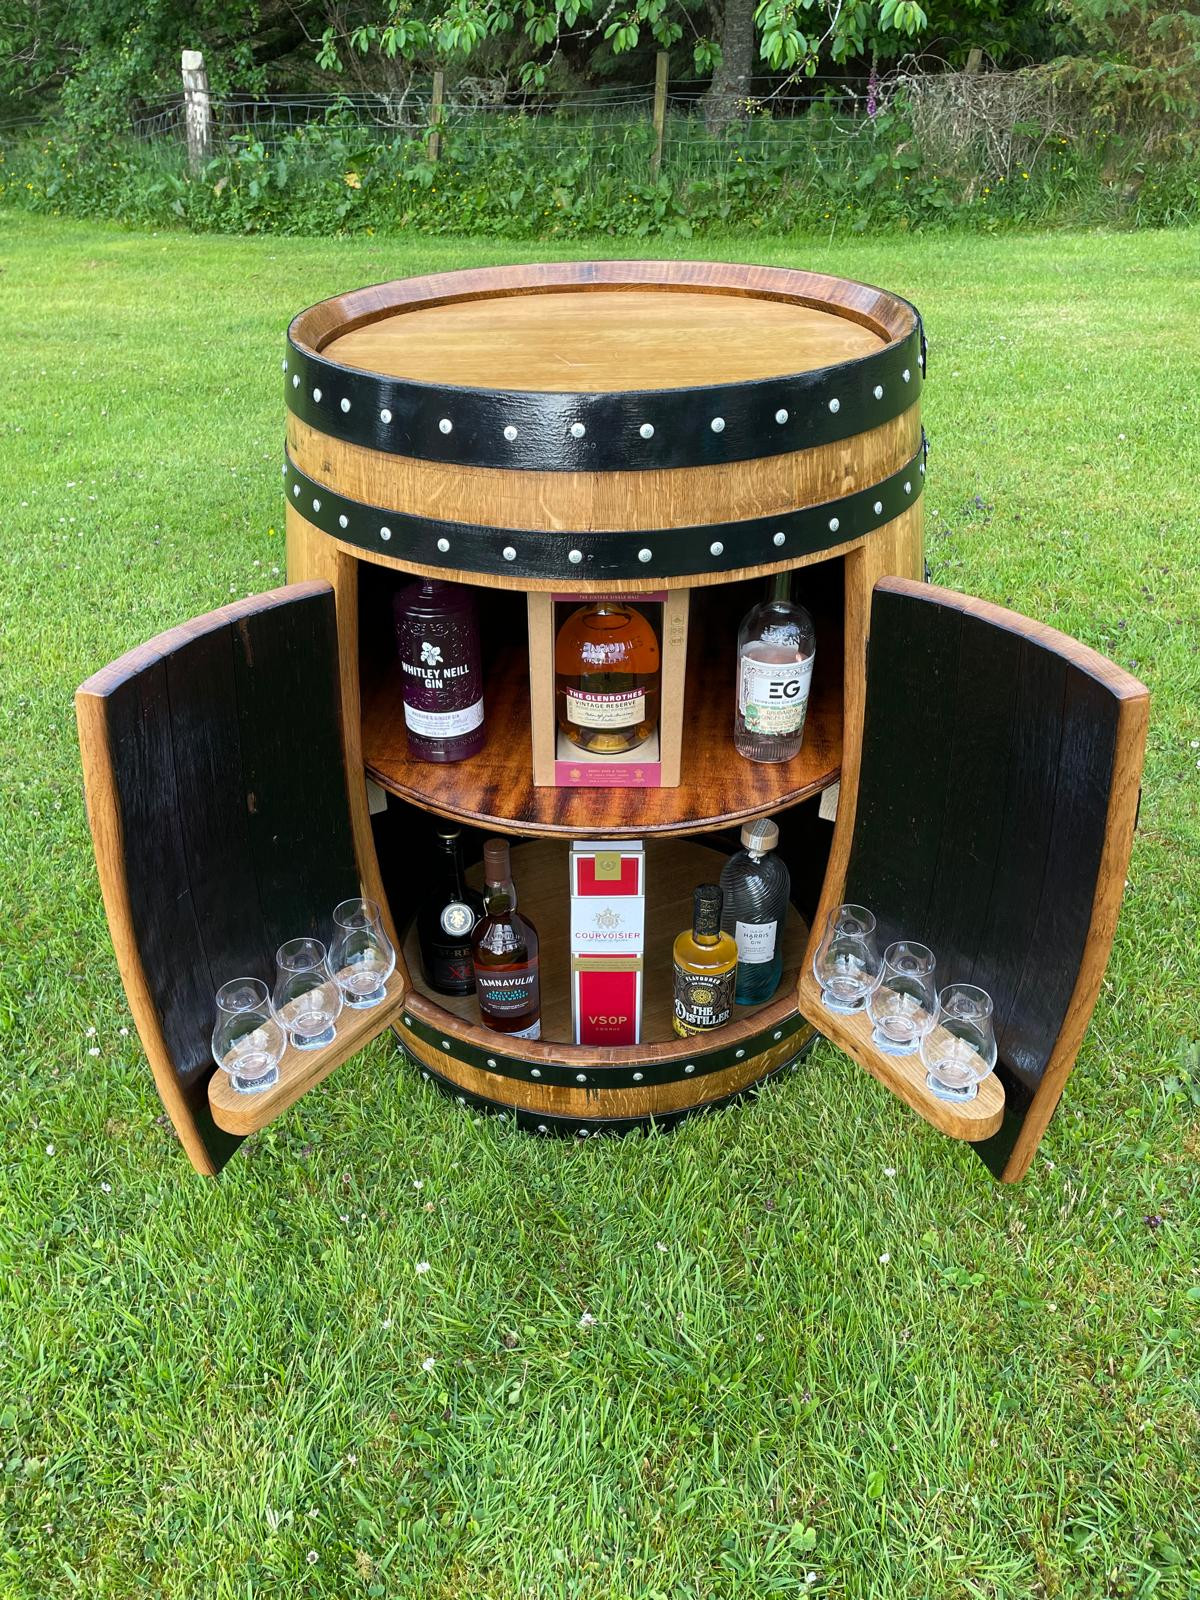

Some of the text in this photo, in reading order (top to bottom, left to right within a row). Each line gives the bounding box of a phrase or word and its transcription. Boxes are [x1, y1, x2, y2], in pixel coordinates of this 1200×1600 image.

[401, 660, 469, 679] WHITLEY NEILL
[424, 679, 443, 689] GIN
[769, 679, 800, 699] EG
[569, 690, 643, 702] THE GLENROTHES
[575, 700, 603, 709] VINTAGE
[605, 700, 636, 709] RESERVE
[743, 932, 769, 940] HARRIS
[479, 975, 536, 987] TAMNAVULIN
[685, 976, 721, 984] FLAVOURED
[674, 998, 730, 1025] DISTILLER
[691, 1005, 714, 1016] THE
[588, 1016, 628, 1025] VSOP
